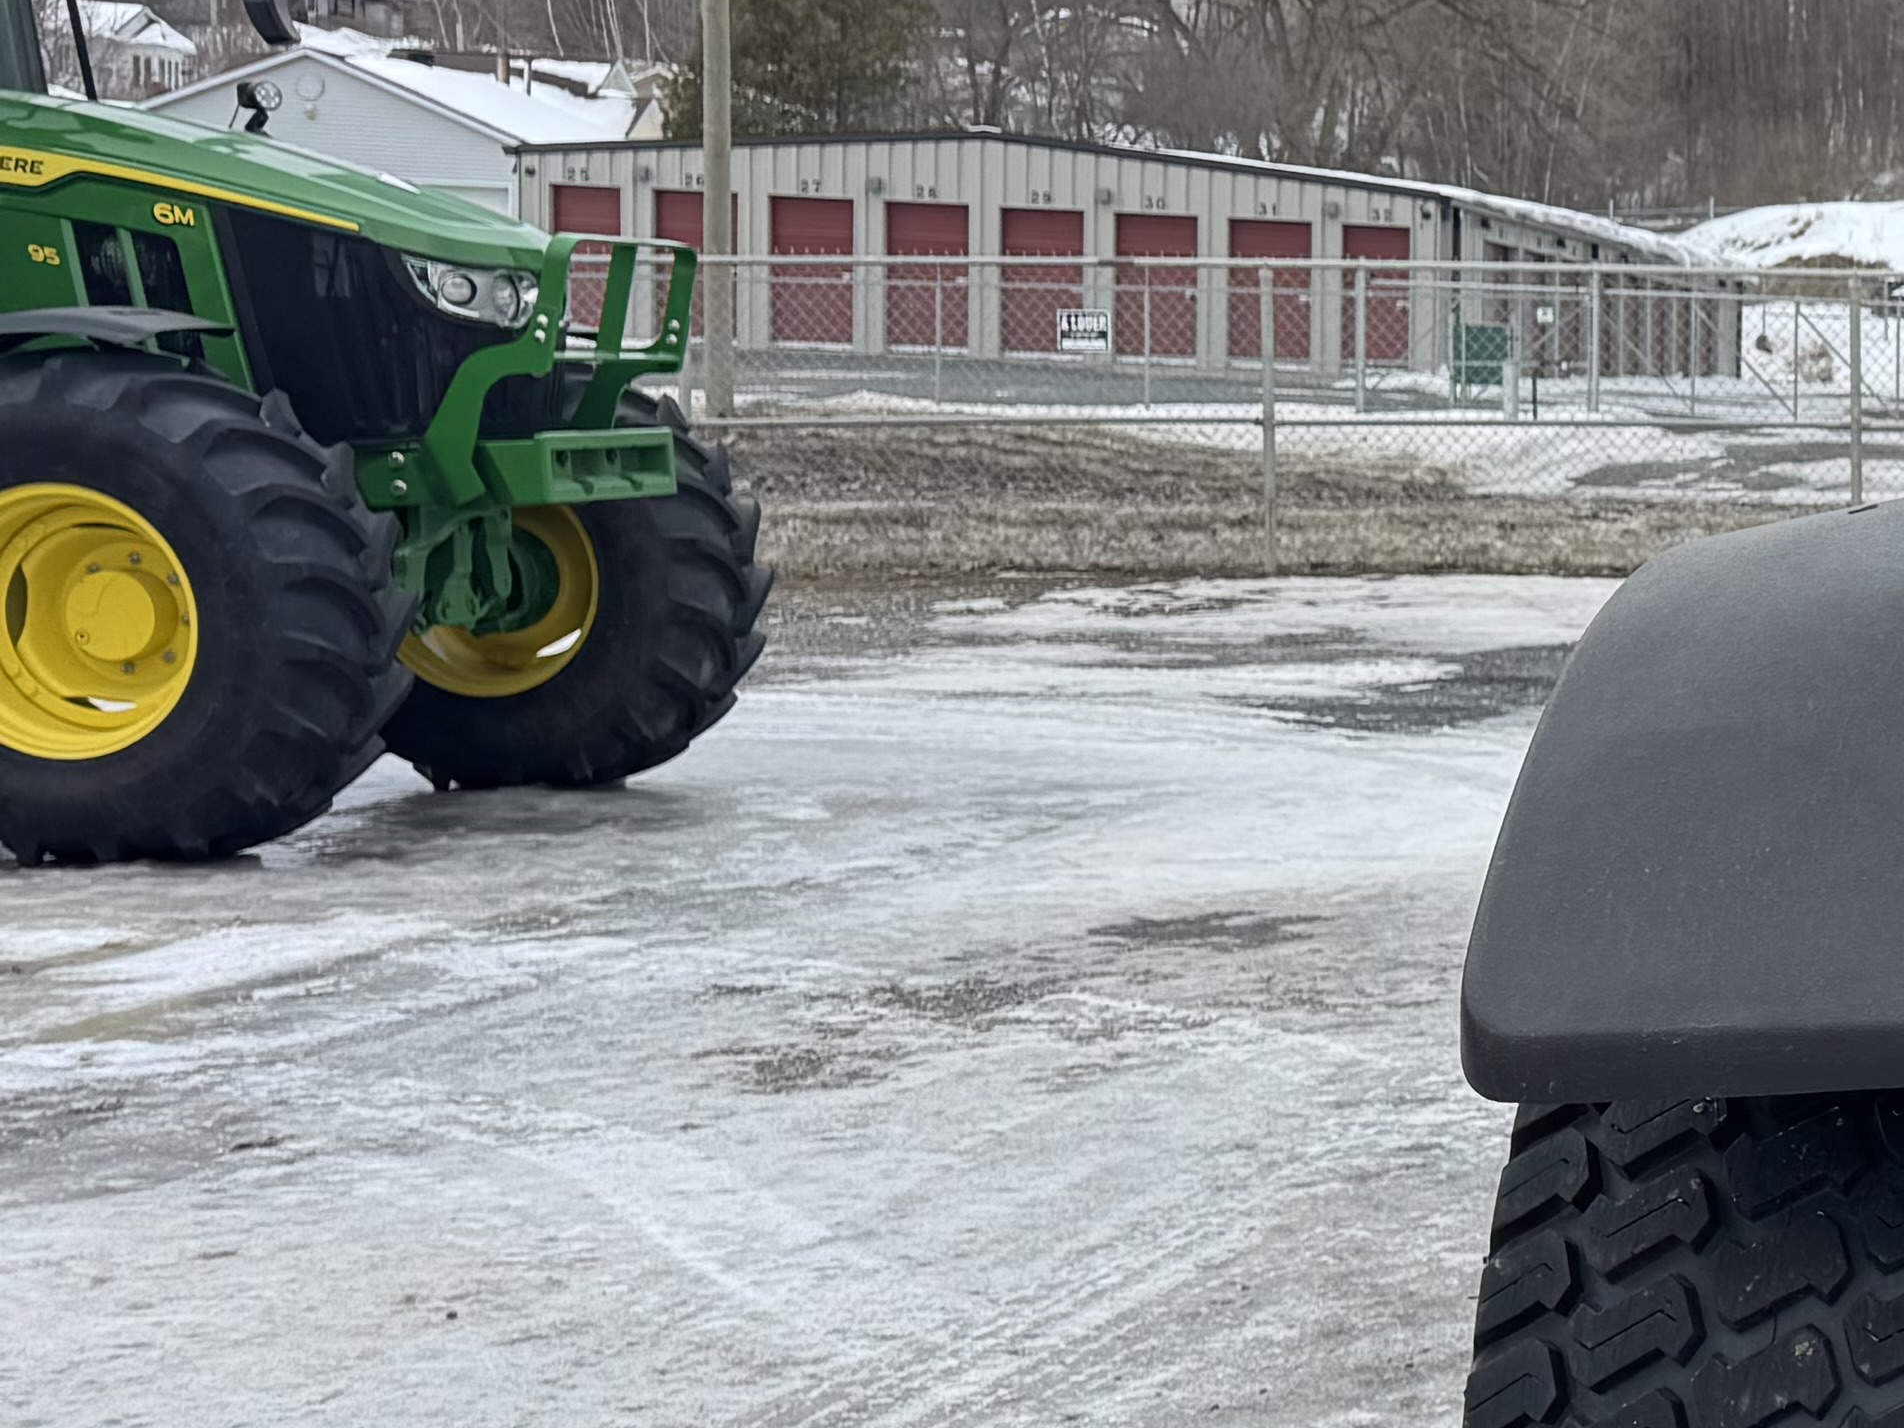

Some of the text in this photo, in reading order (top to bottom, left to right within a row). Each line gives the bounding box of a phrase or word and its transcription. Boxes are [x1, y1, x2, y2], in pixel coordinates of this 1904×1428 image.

[801, 178, 822, 193] 27
[1144, 196, 1166, 210] 30
[153, 202, 196, 227] 6M
[28, 244, 61, 266] 95
